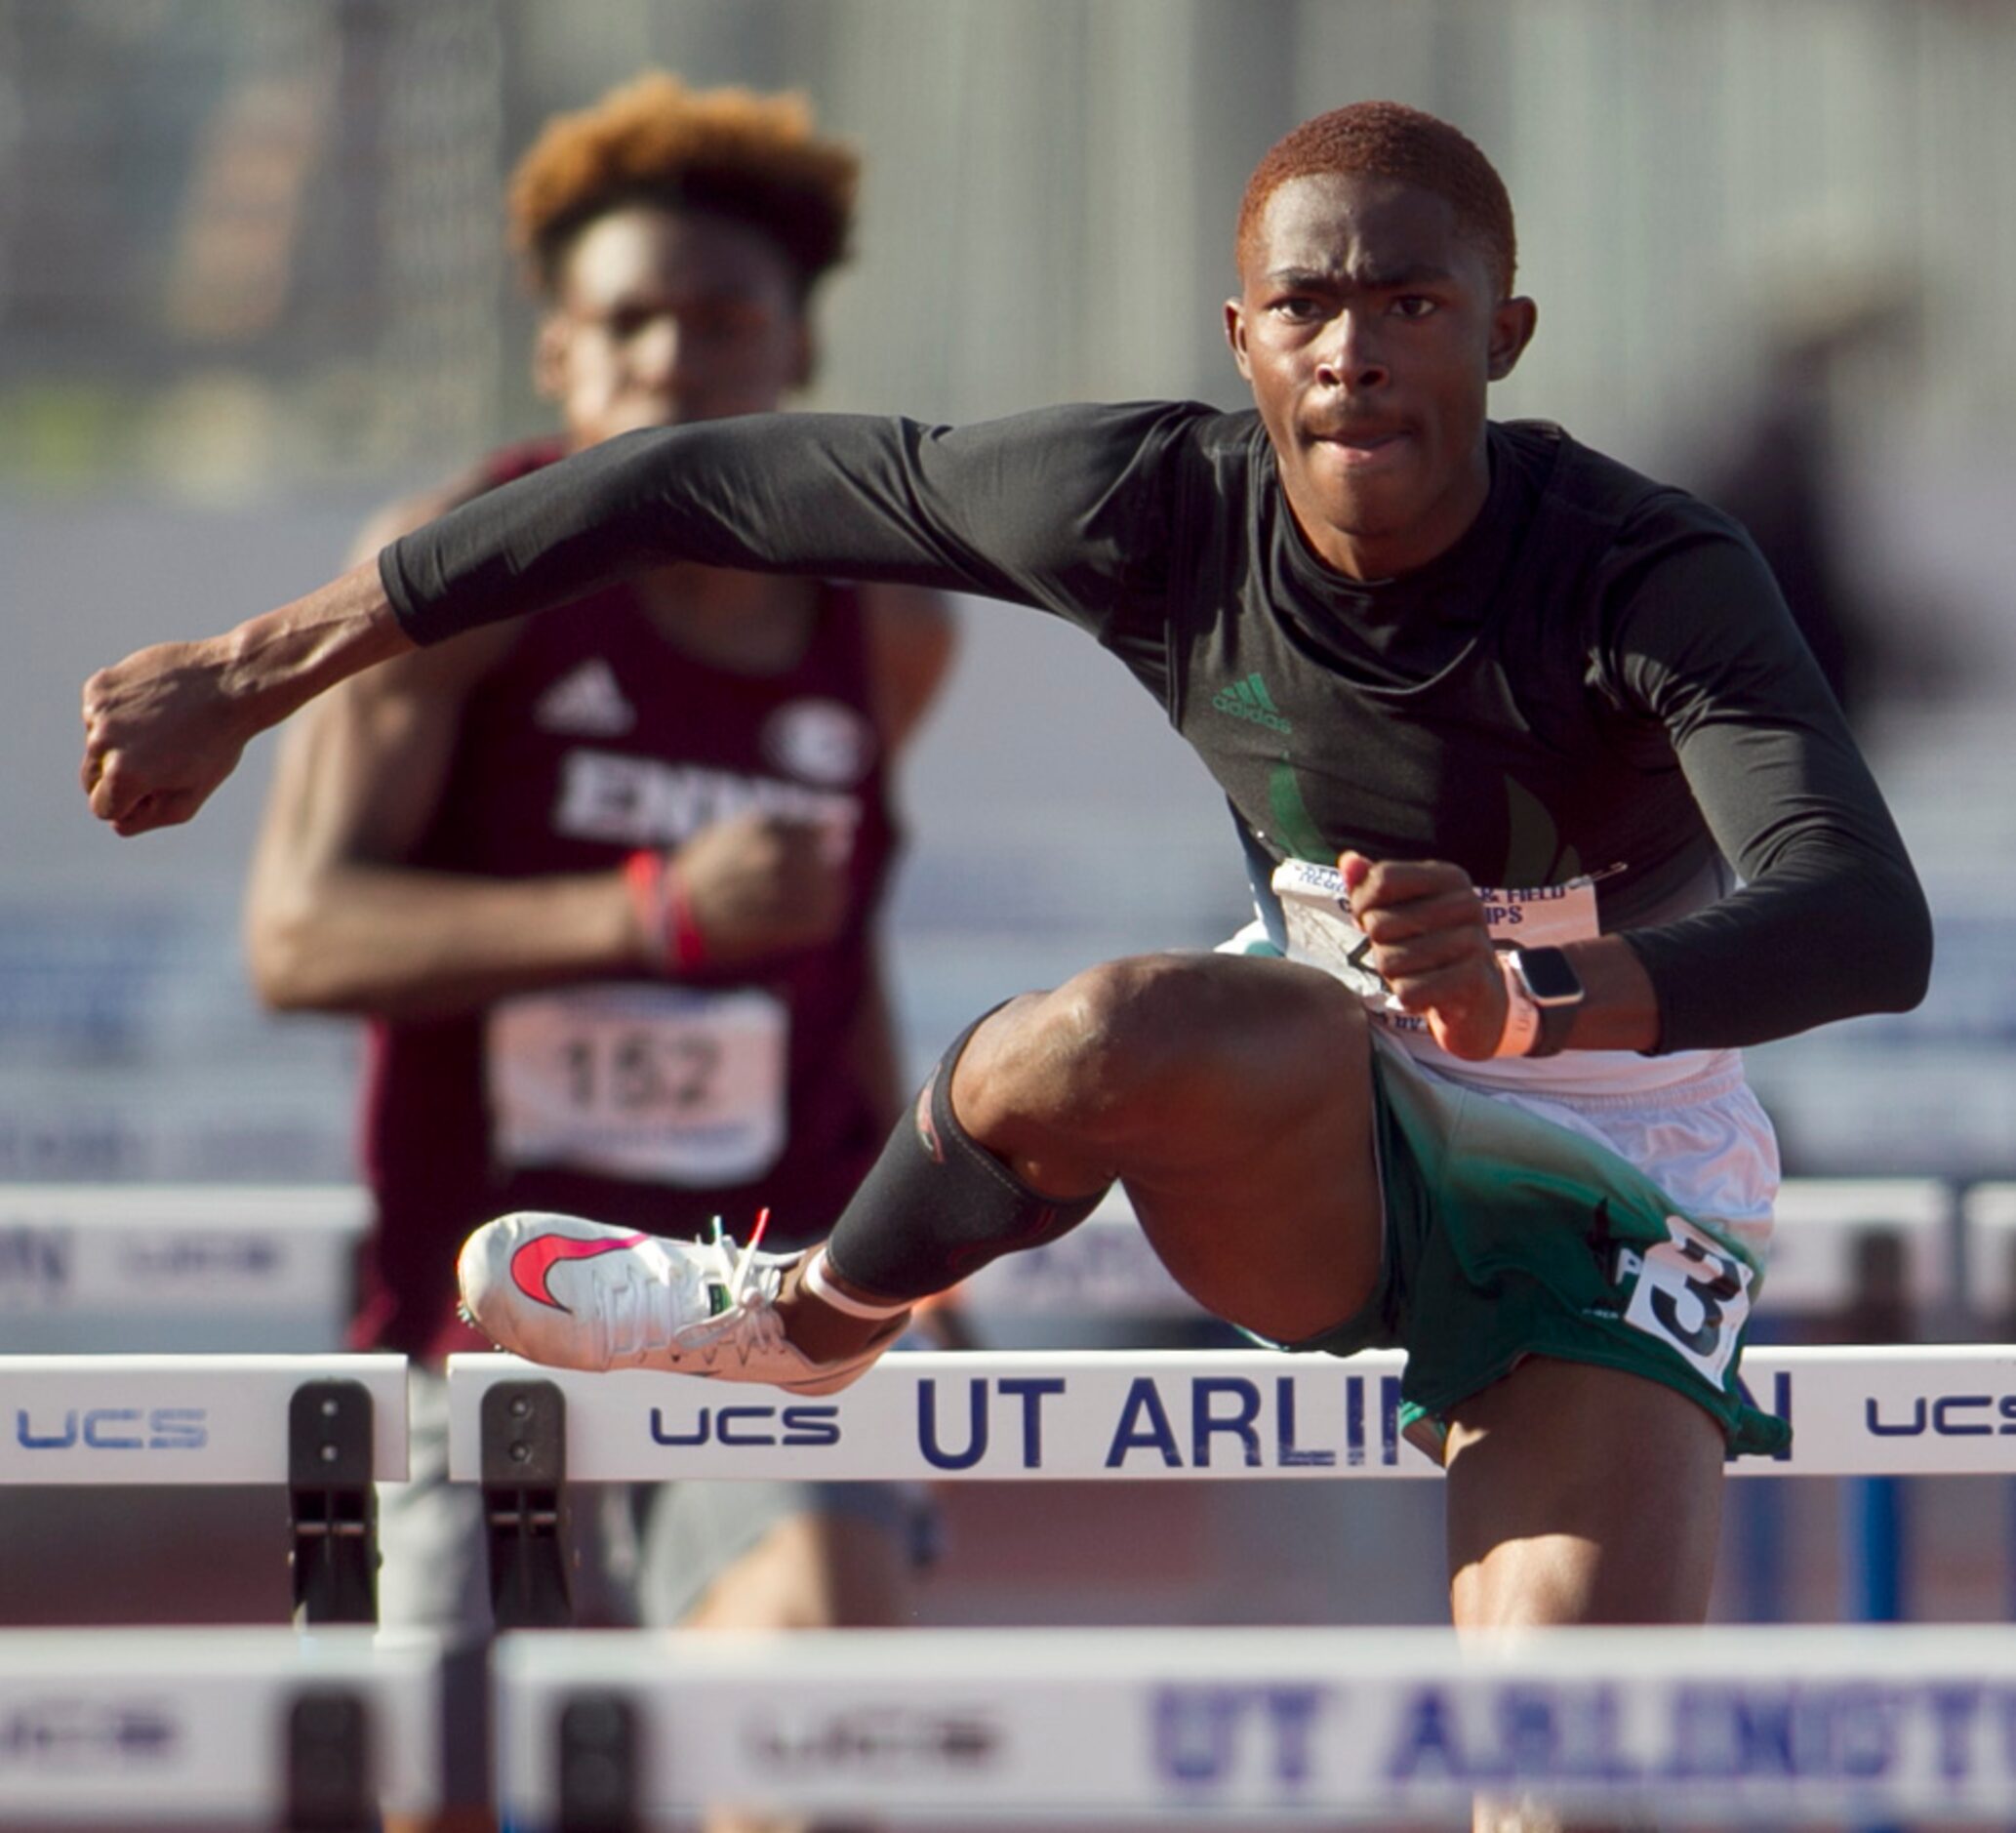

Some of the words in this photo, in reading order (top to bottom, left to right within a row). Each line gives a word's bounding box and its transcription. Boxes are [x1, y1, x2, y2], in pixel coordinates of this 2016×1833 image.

[1212, 694, 1293, 734] adidas
[1650, 1237, 1742, 1358] 3
[17, 1408, 207, 1448] UCS
[651, 1406, 840, 1446] UCS
[918, 1377, 1066, 1470] UT
[1151, 1684, 1325, 1781] UT
[1389, 1682, 2016, 1780] ARLINGT
